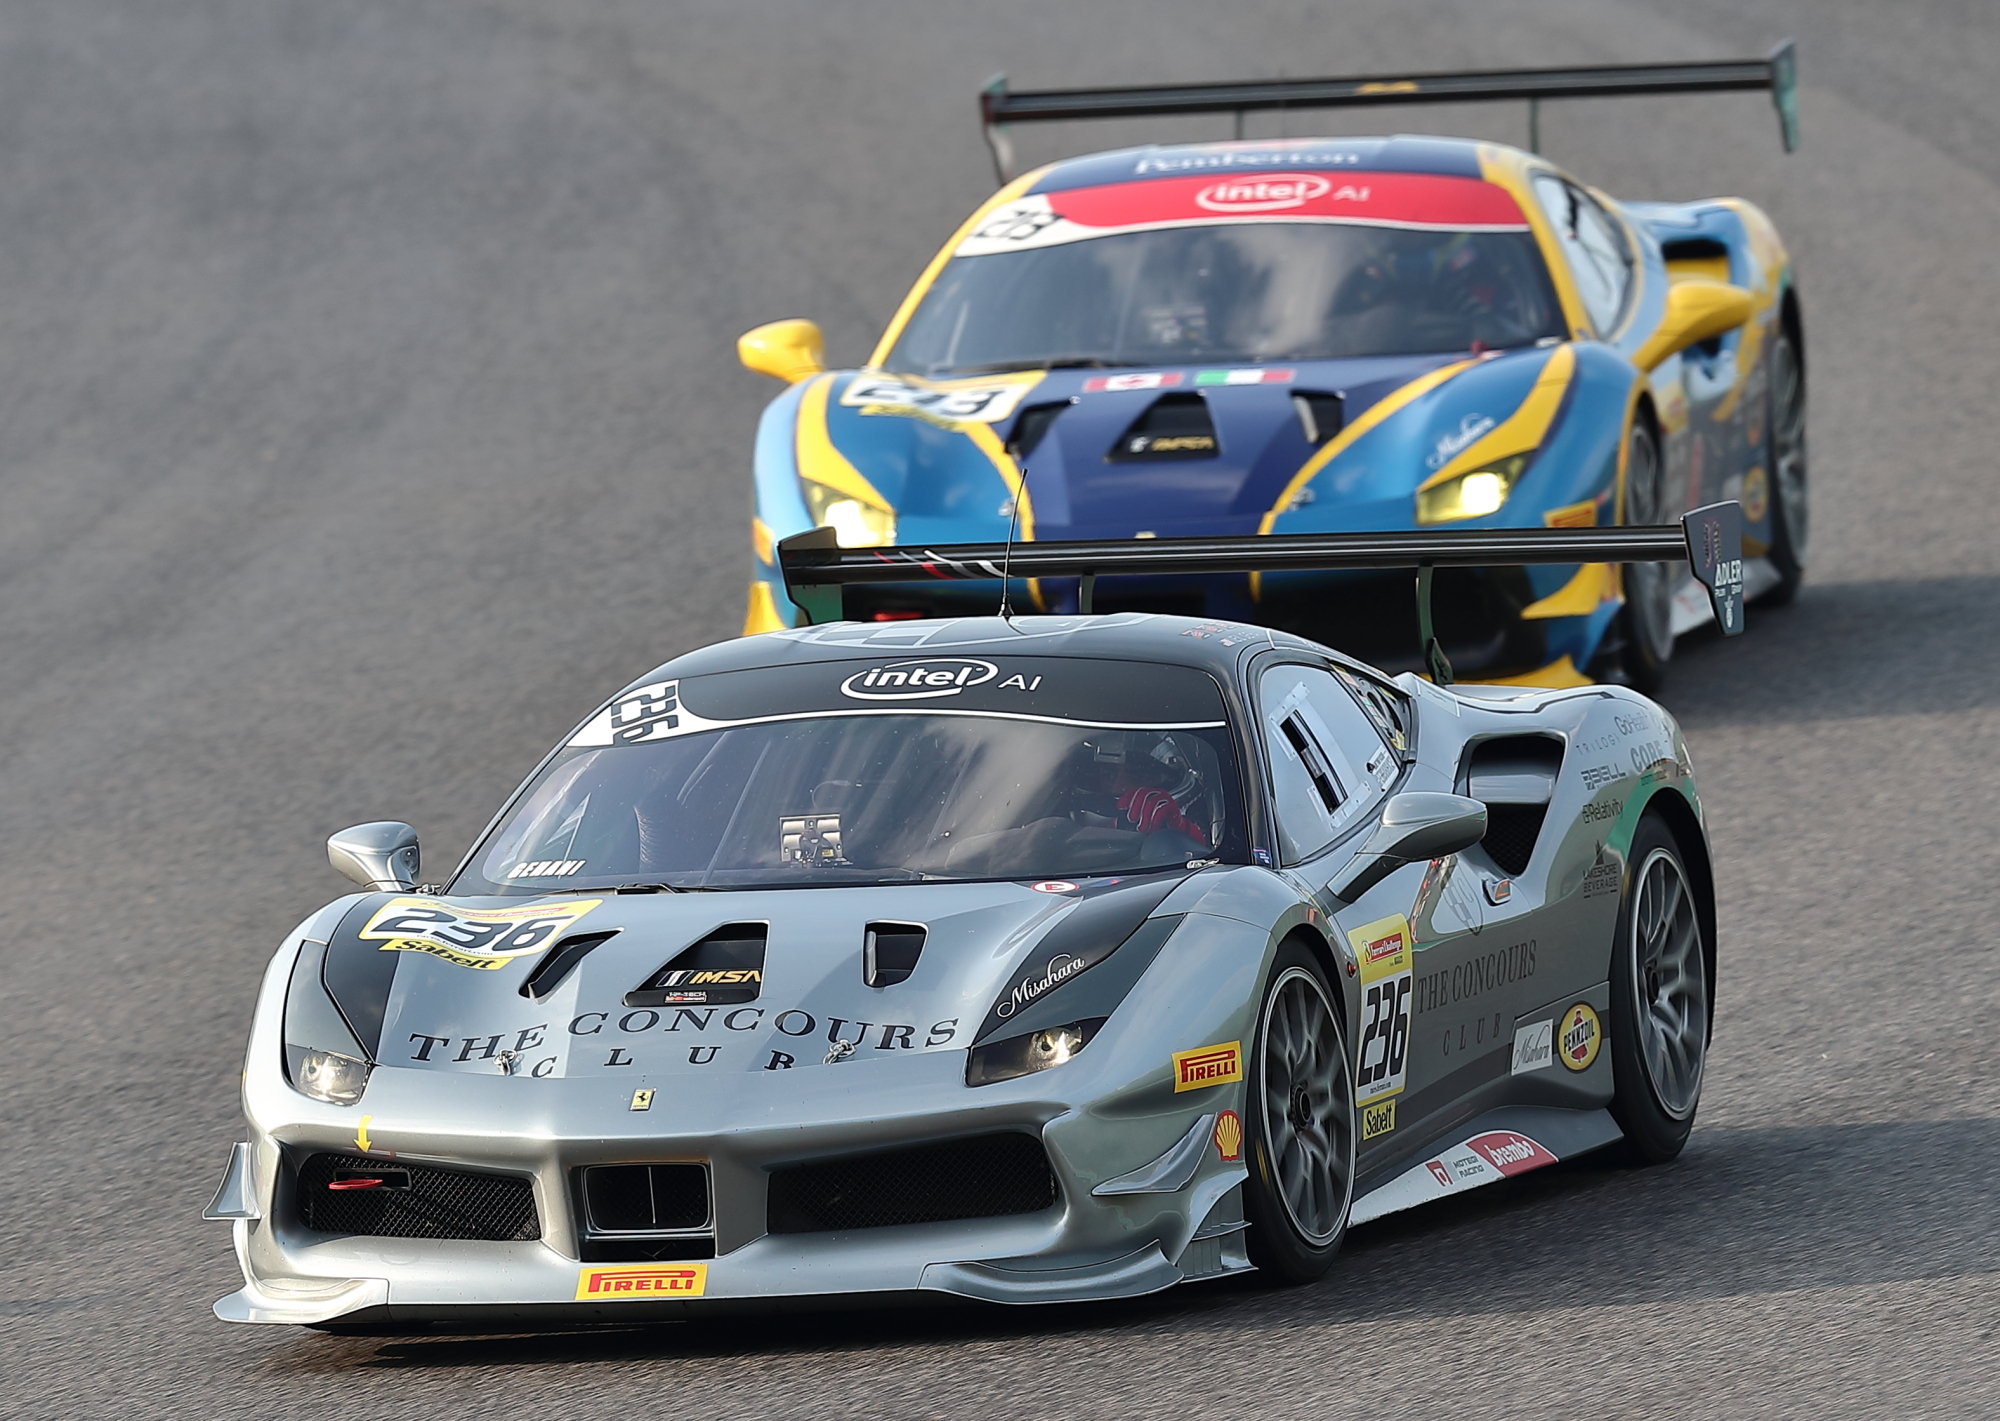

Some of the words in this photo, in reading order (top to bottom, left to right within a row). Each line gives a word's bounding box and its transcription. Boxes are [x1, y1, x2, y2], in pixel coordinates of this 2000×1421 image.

[1215, 181, 1308, 201] intel
[1332, 184, 1370, 202] AI
[1715, 559, 1742, 587] ADLER
[862, 667, 972, 687] intel
[998, 673, 1042, 691] AI
[370, 908, 575, 951] 236
[395, 940, 498, 969] Sabelt
[688, 970, 761, 985] IMSA
[997, 953, 1085, 1018] Misahara
[1418, 969, 1449, 1014] THE
[1452, 939, 1537, 1002] CONCOURS
[409, 1023, 548, 1062] THE
[568, 1007, 960, 1050] CONCOURS
[1357, 975, 1411, 1088] 236
[1563, 1018, 1595, 1054] PENNZOIL
[1180, 1050, 1236, 1083] PIRELLI
[1366, 1107, 1393, 1137] Sabelt
[1453, 1155, 1479, 1169] MOTEGI
[1484, 1136, 1536, 1166] brembo
[1459, 1164, 1485, 1178] RACING
[588, 1270, 696, 1293] PIRELLI
